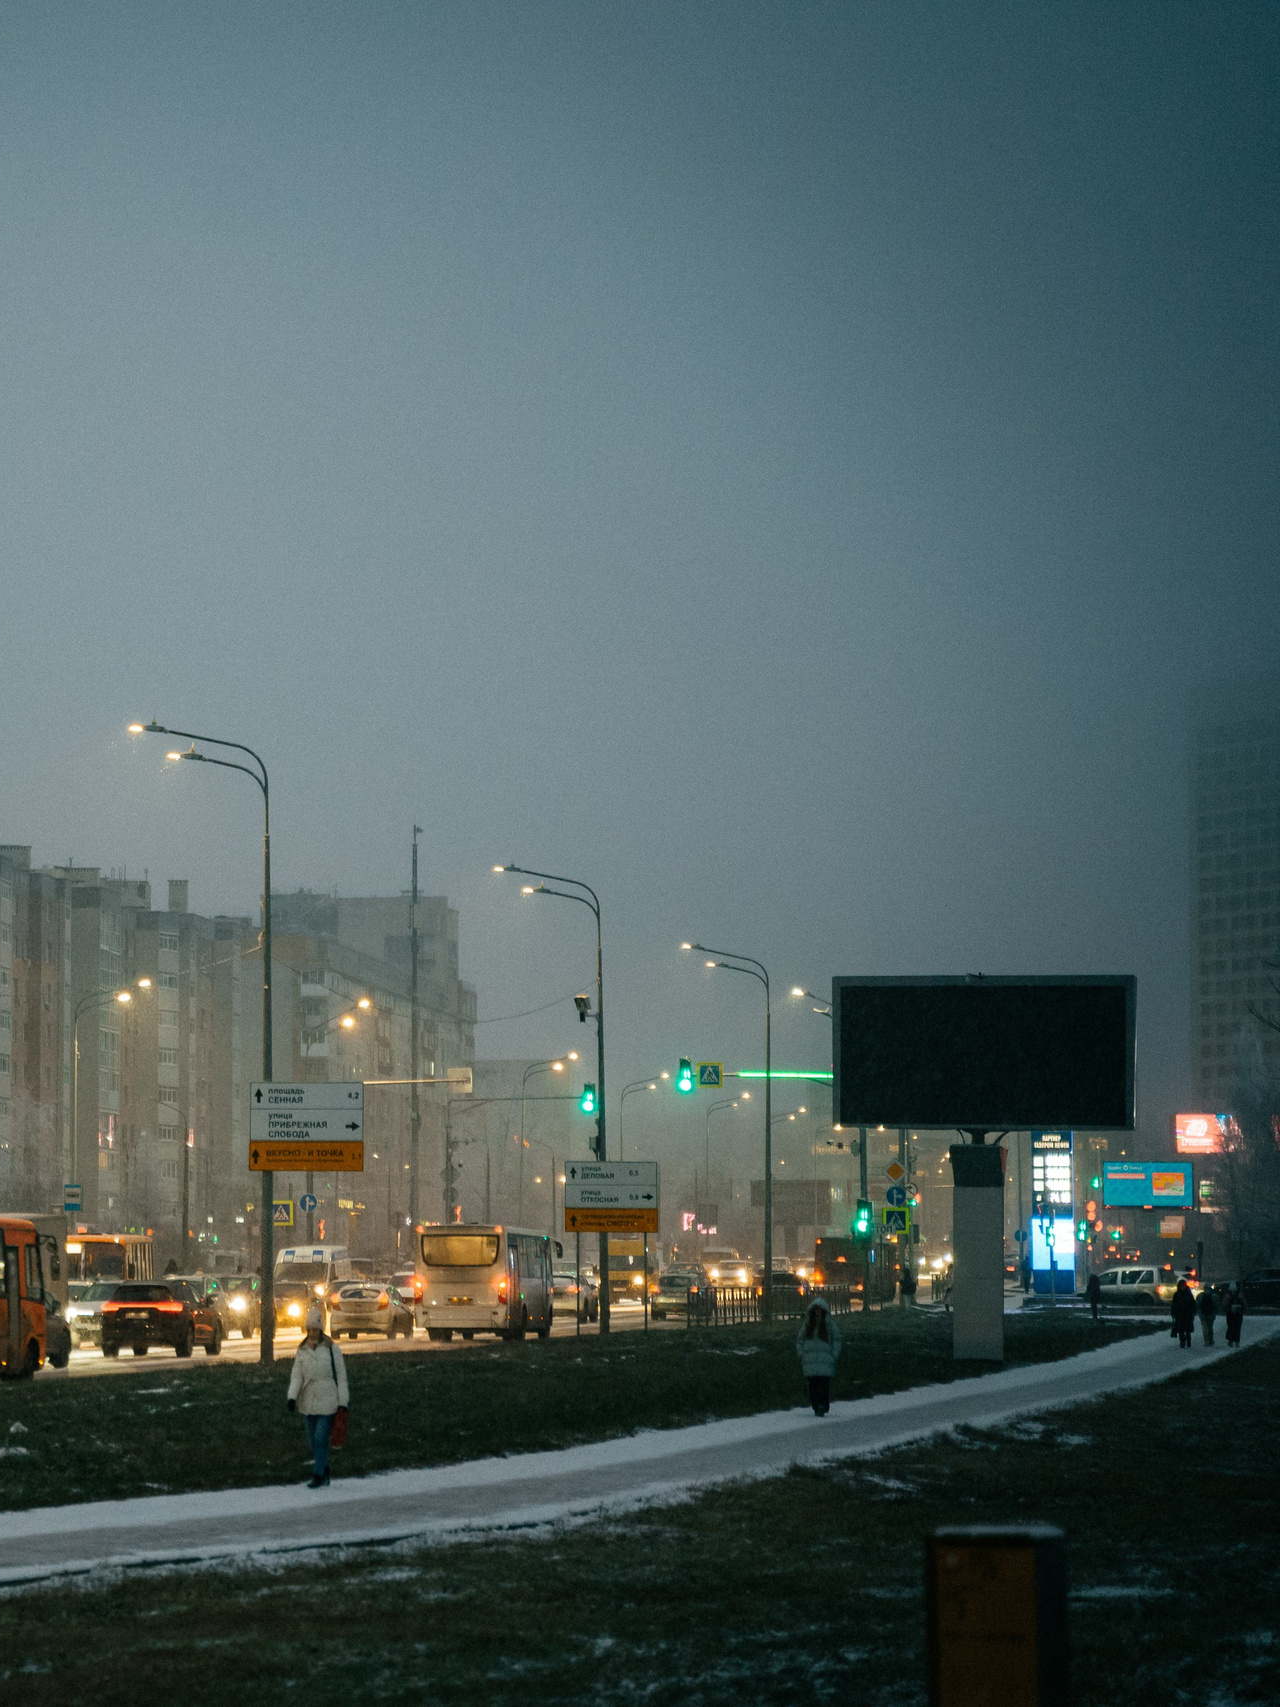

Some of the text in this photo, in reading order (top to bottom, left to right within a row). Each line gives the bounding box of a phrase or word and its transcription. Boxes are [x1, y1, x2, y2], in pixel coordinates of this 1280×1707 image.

[268, 1088, 305, 1096] площадь
[268, 1096, 303, 1104] СЕННАЯ
[268, 1112, 293, 1120] улица
[268, 1121, 328, 1129] ПРИБРЕЖНАЯ
[268, 1131, 310, 1139] СЛОБОДА
[266, 1149, 301, 1158] ВКУСНО
[307, 1150, 315, 1158] И
[316, 1150, 344, 1158] ТОЧКА
